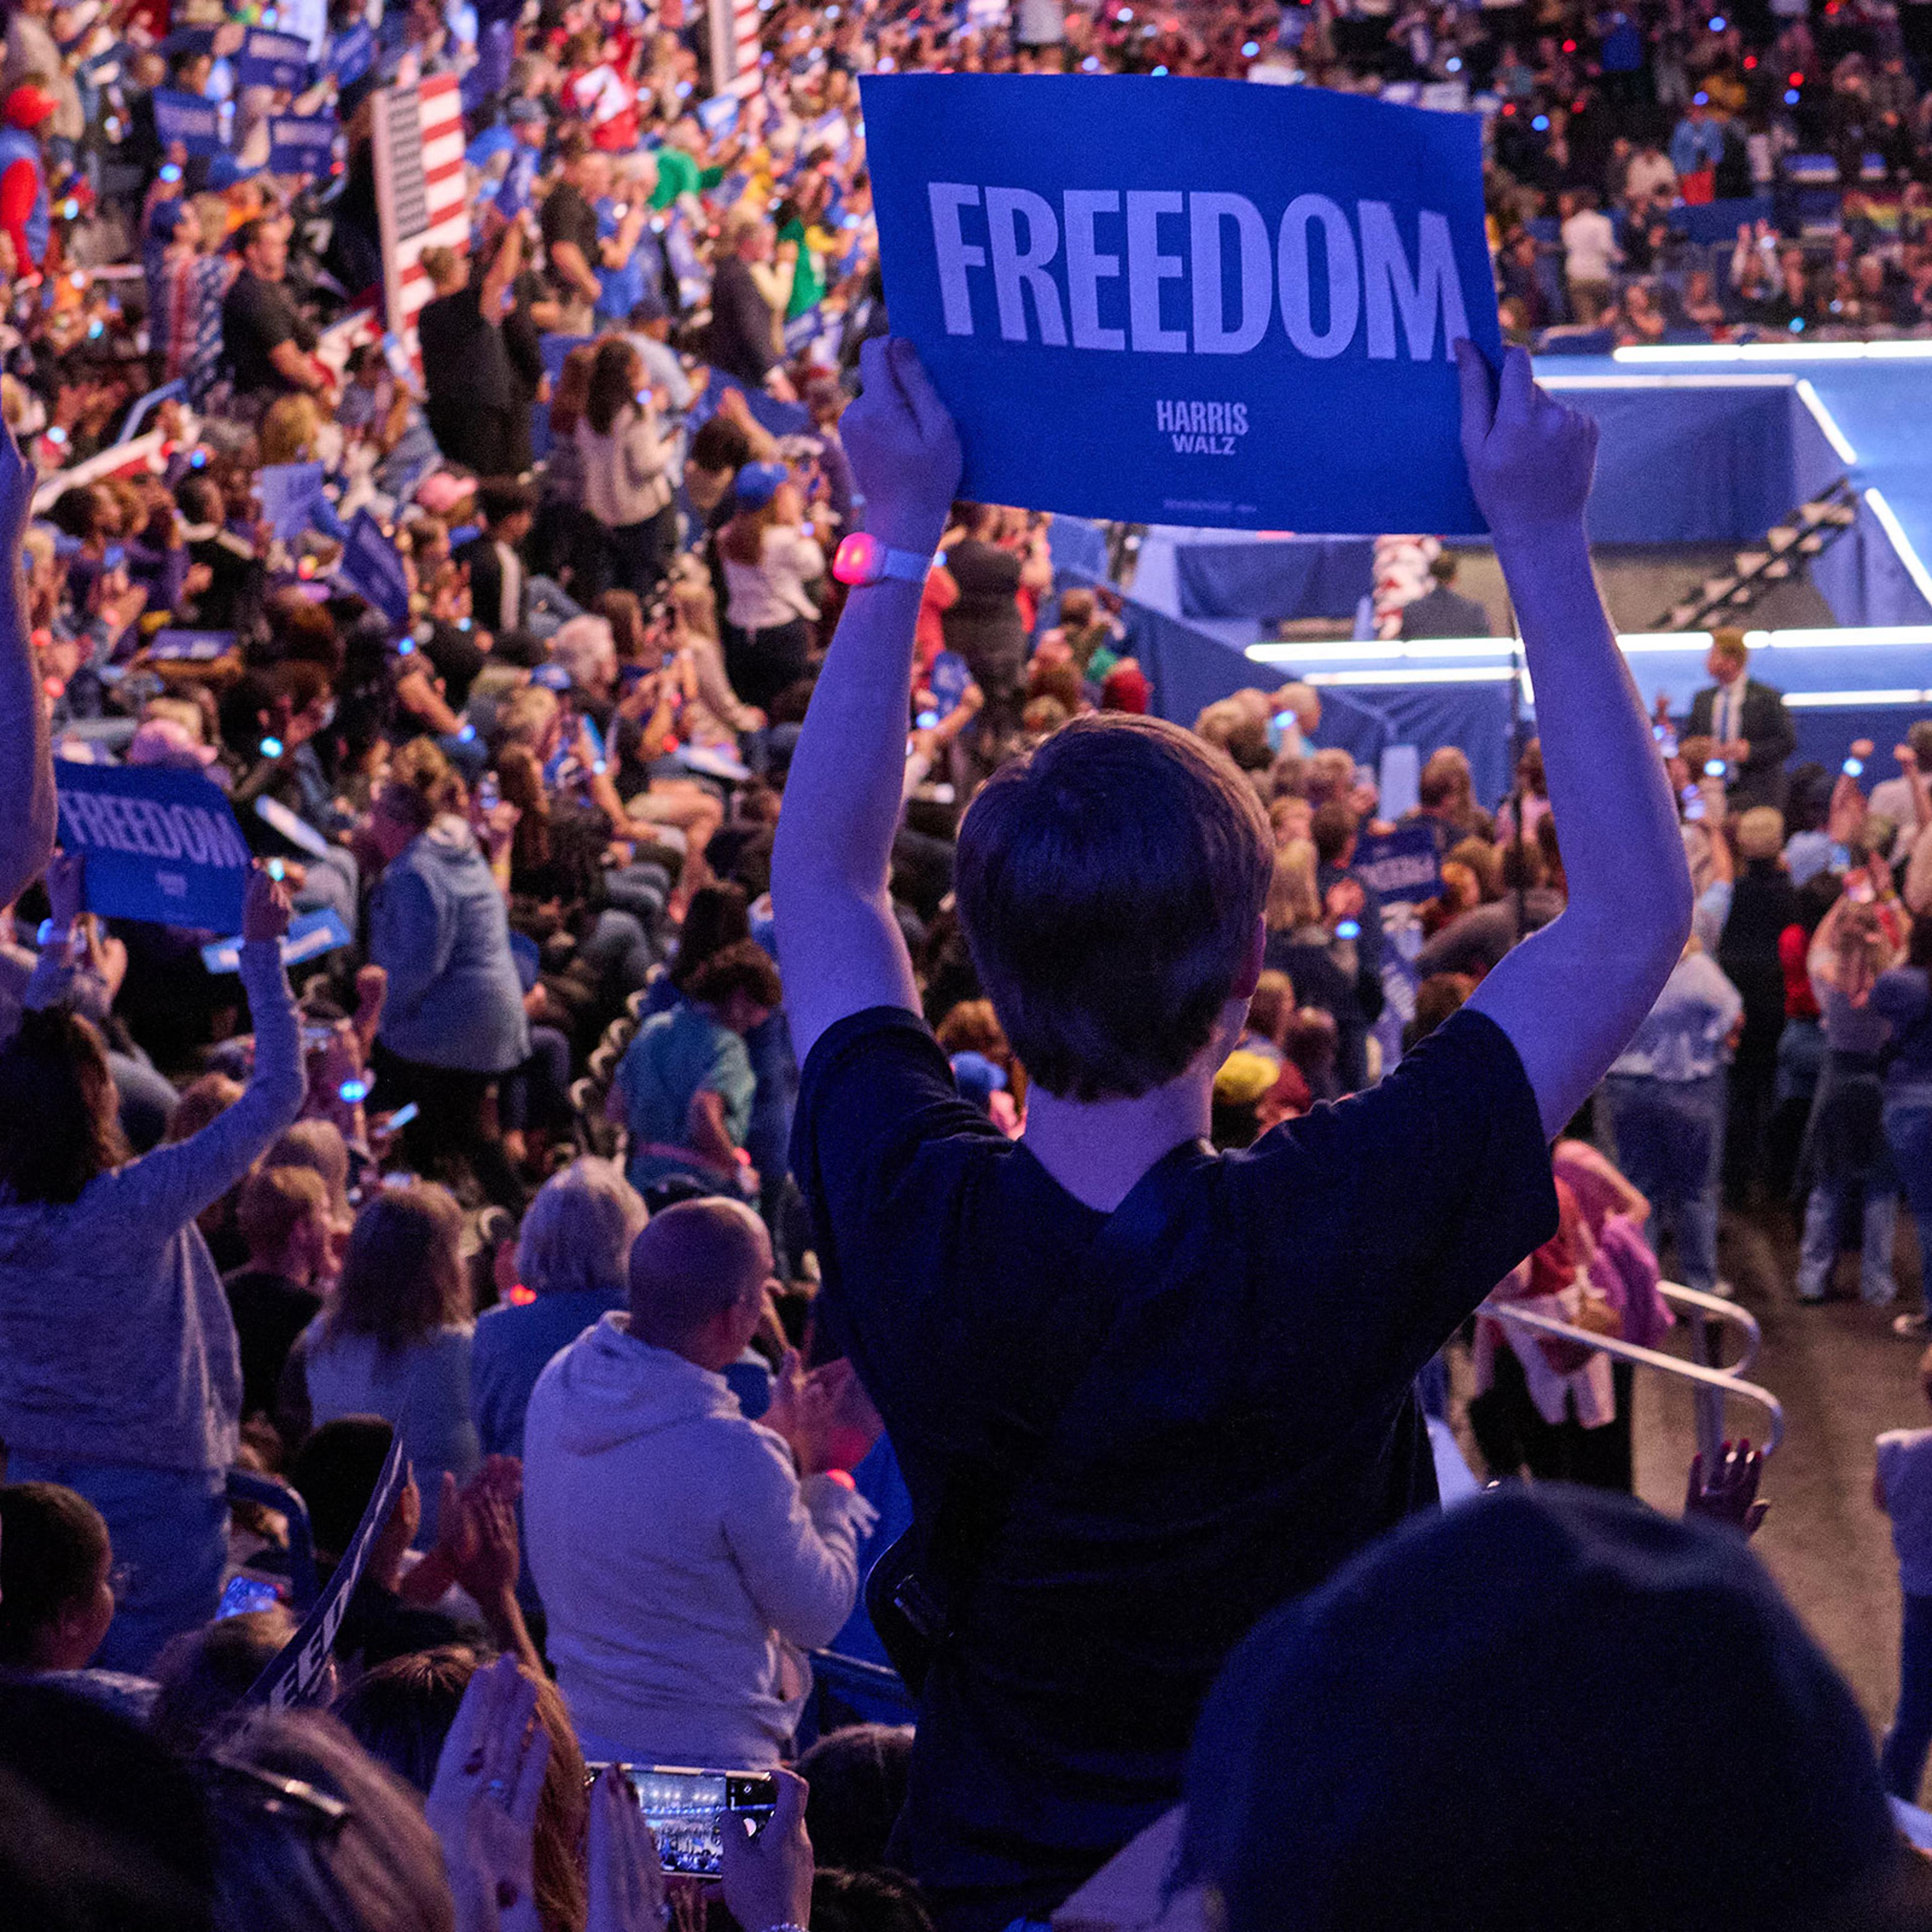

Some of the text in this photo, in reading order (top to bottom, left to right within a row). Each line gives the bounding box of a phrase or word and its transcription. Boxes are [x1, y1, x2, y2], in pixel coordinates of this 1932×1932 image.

[928, 182, 1470, 362] FREEDOM
[1157, 400, 1249, 436] HARRIS
[1172, 434, 1236, 455] WALZ
[58, 790, 250, 868] FREEDOM
